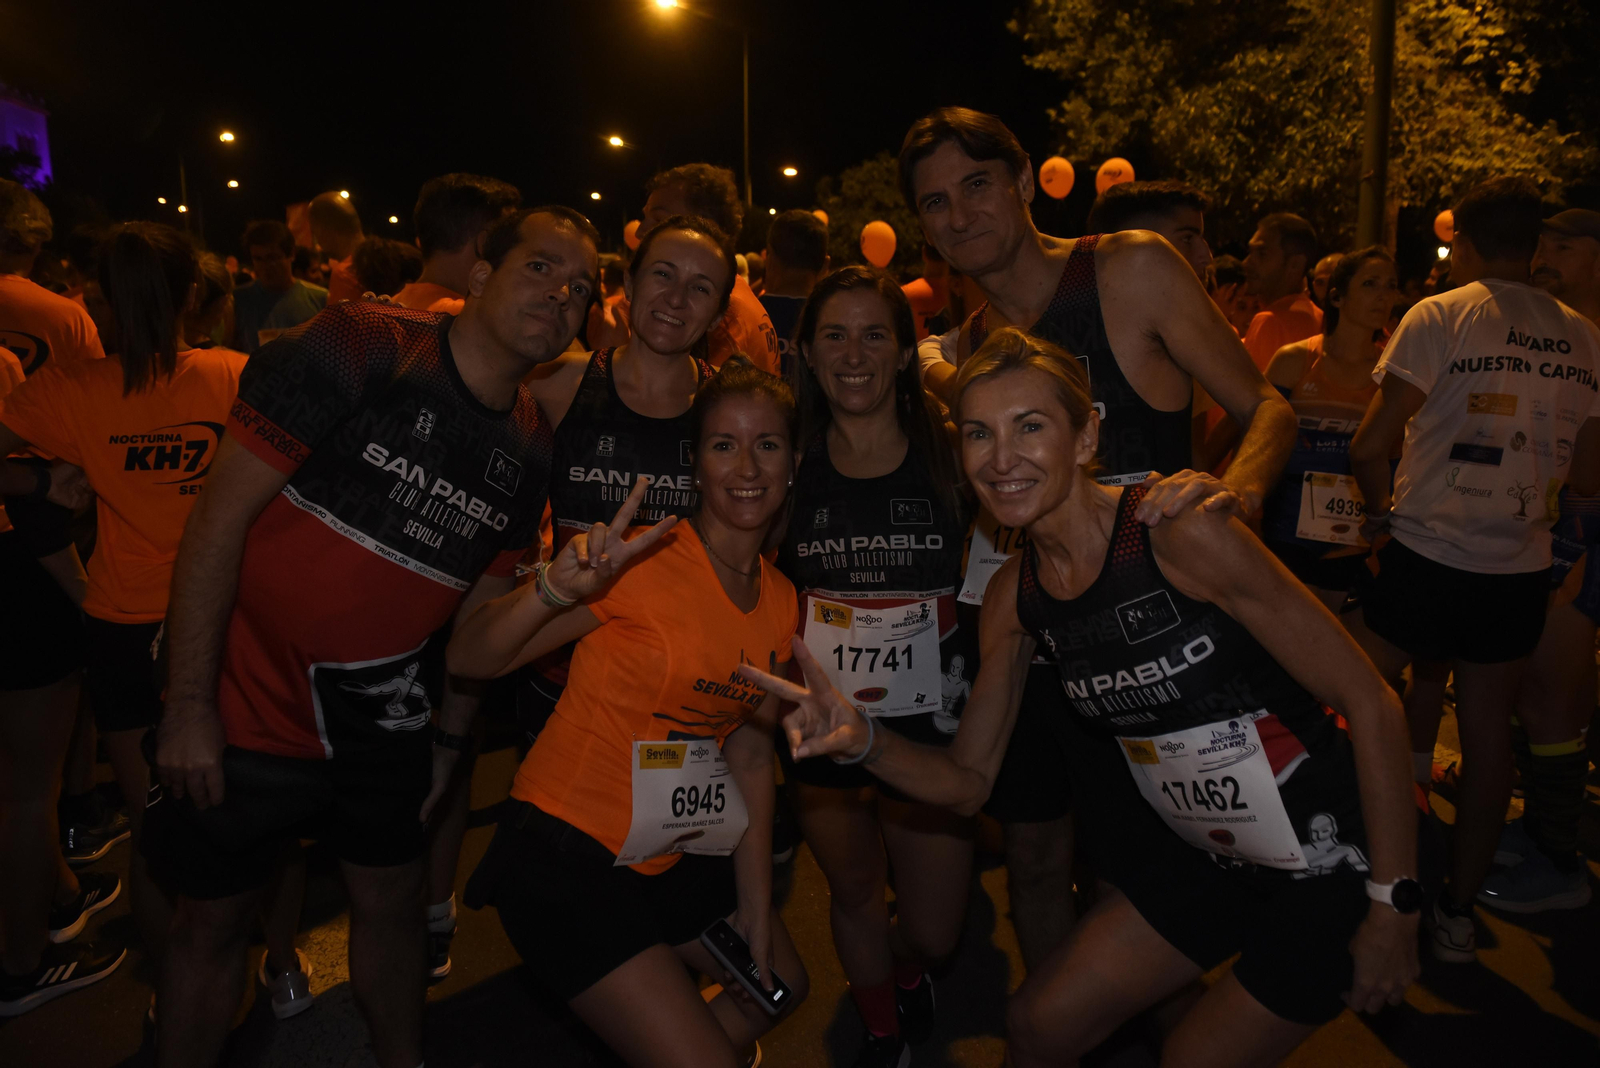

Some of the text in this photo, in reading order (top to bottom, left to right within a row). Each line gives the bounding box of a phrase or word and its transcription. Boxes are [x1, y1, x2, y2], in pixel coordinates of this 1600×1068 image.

[1506, 326, 1571, 355] ÁLVARO
[1450, 355, 1532, 375] NUESTRO
[109, 433, 182, 445] NOCTURNA
[362, 442, 509, 532] SAN PABLO
[569, 466, 631, 486] SAN
[643, 490, 698, 507] TLETISMO
[388, 481, 480, 541] CLUB ATLETISMO
[632, 508, 667, 521] EVILLA
[283, 486, 327, 519] ONTAÑISMO
[329, 519, 367, 544] RUNNING
[374, 544, 410, 566] TRIATLÓN
[403, 519, 444, 550] SEVILLA
[797, 534, 943, 557] SAN PABLO
[822, 551, 913, 570] CLUB ATLETISMO
[850, 570, 886, 584] SEVILLA
[832, 644, 913, 673] 17741
[1091, 634, 1215, 695] PABLO
[693, 678, 749, 702] SEVILLA
[1101, 680, 1181, 713] ATLETISMO
[1197, 744, 1229, 756] SEVILLA
[1210, 732, 1247, 745] NOCTURNA
[671, 783, 725, 818] 6945
[1161, 776, 1248, 812] 17462
[662, 822, 691, 830] ESPERANZA
[708, 818, 725, 826] SALCES
[1224, 815, 1258, 824] RODRIGUEZ
